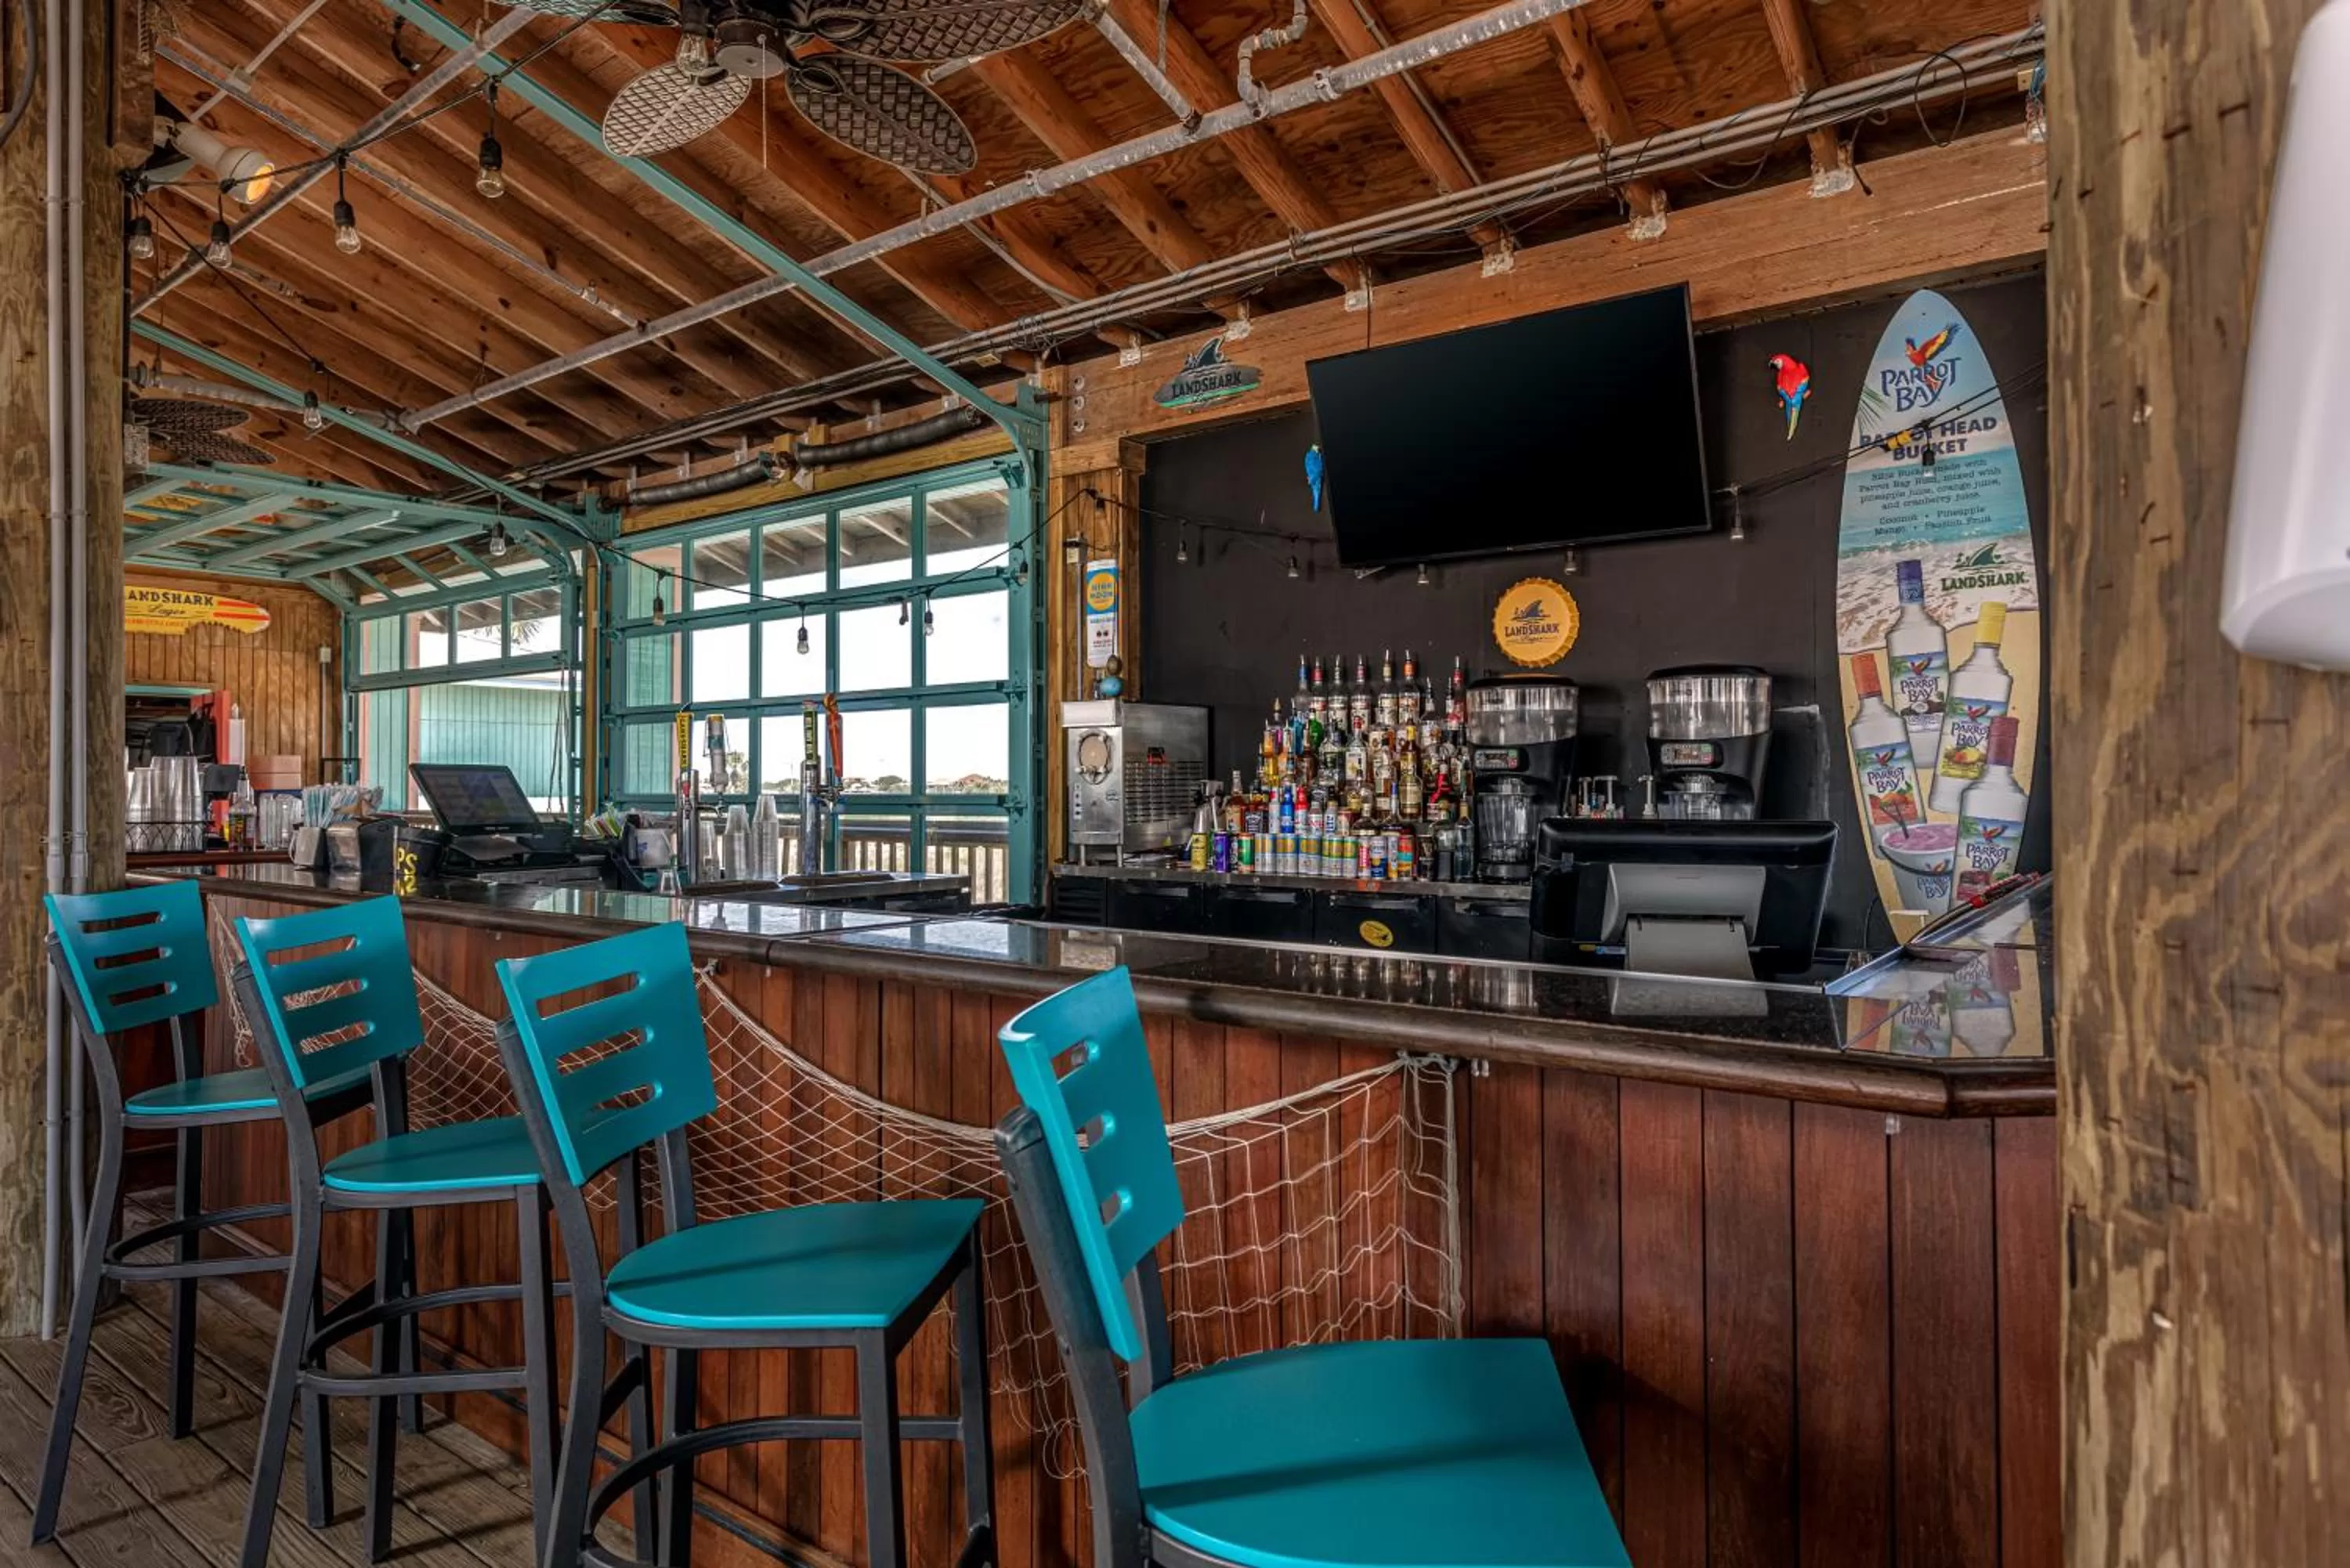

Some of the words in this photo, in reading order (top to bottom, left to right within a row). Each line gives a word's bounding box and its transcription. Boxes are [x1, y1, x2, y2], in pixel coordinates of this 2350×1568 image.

[1171, 370, 1242, 398] LANDSHARK
[1880, 357, 1961, 397] PARROT
[1896, 377, 1949, 413] BAY
[1940, 417, 1998, 438] HEAD
[1859, 482, 1889, 493] Parrot
[1881, 500, 1900, 509] and
[1936, 505, 1987, 518] Pineapple
[1941, 572, 2026, 591] LANDSHARK
[127, 589, 214, 606] ANDSHARK
[1505, 623, 1560, 638] LANDSHARK
[1900, 676, 1940, 694] PARROT
[1908, 687, 1933, 703] BAY
[1956, 732, 1984, 747] BAY
[1867, 766, 1905, 786] PARROT
[1876, 779, 1900, 793] BAY
[1965, 843, 2011, 862] PARROT
[1972, 854, 2001, 872] BAY
